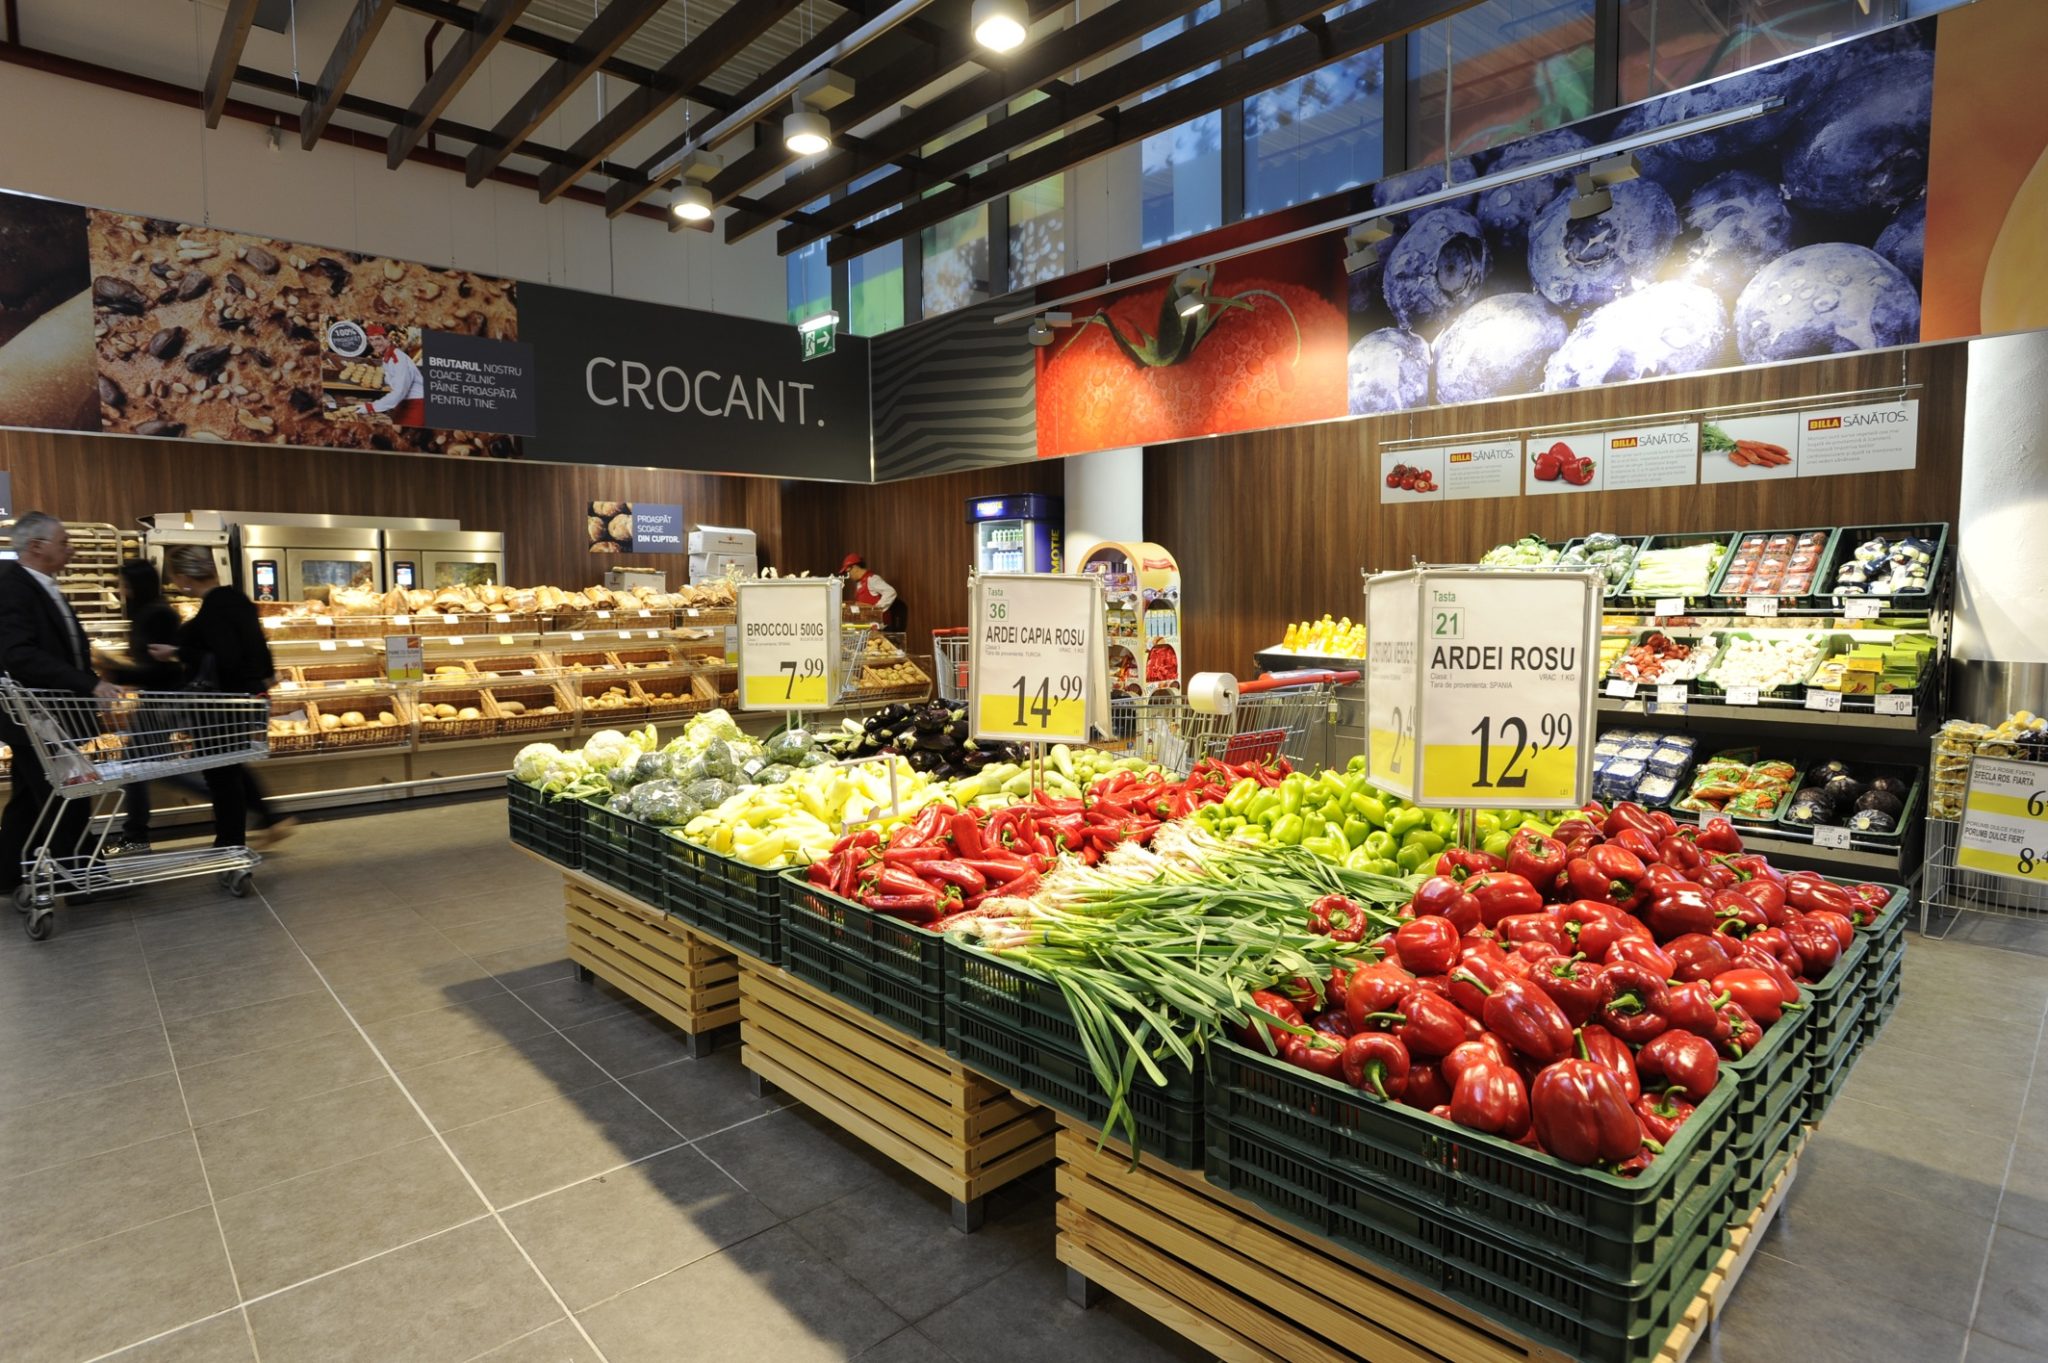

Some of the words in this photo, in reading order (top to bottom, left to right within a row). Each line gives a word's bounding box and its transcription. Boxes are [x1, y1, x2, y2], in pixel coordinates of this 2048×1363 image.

[429, 356, 481, 372] BRUTARUL
[483, 363, 522, 376] NOSTRU
[429, 369, 462, 381] COACE
[465, 373, 496, 385] ZILNIC
[430, 379, 459, 394] PÂINE
[462, 383, 517, 400] PROASPĂTĂ
[586, 356, 824, 427] CROCANT.
[430, 394, 470, 407] PENTRU
[474, 398, 498, 410] TINE.
[1810, 418, 1840, 430] BILLA
[1843, 411, 1908, 428] SĂNĂTOS.
[1612, 438, 1636, 448] BILLA
[1450, 453, 1472, 462] BILLA
[637, 514, 672, 523] PROASPĂT
[1051, 528, 1060, 573] MOTIE
[988, 588, 1004, 596] Tasta
[1433, 590, 1456, 602] Tasta
[990, 603, 1006, 619] 36
[747, 623, 798, 636] BROCCOLI
[800, 623, 824, 636] 500G
[1435, 612, 1457, 635] 21
[986, 626, 1018, 643] ARDEI
[1021, 628, 1052, 645] CAPIA
[1055, 629, 1085, 646] ROSU
[1430, 646, 1502, 670] ARDEI
[1512, 647, 1575, 670] ROSU
[780, 658, 824, 700] 7,99
[1012, 675, 1082, 728] 14,99
[1471, 713, 1572, 788] 12,99
[1974, 771, 1996, 781] SFECLA
[2012, 776, 2034, 786] FIARTA
[1965, 827, 1987, 839] PORUMB
[1989, 831, 2007, 841] DULCE
[2008, 834, 2024, 844] FIERT
